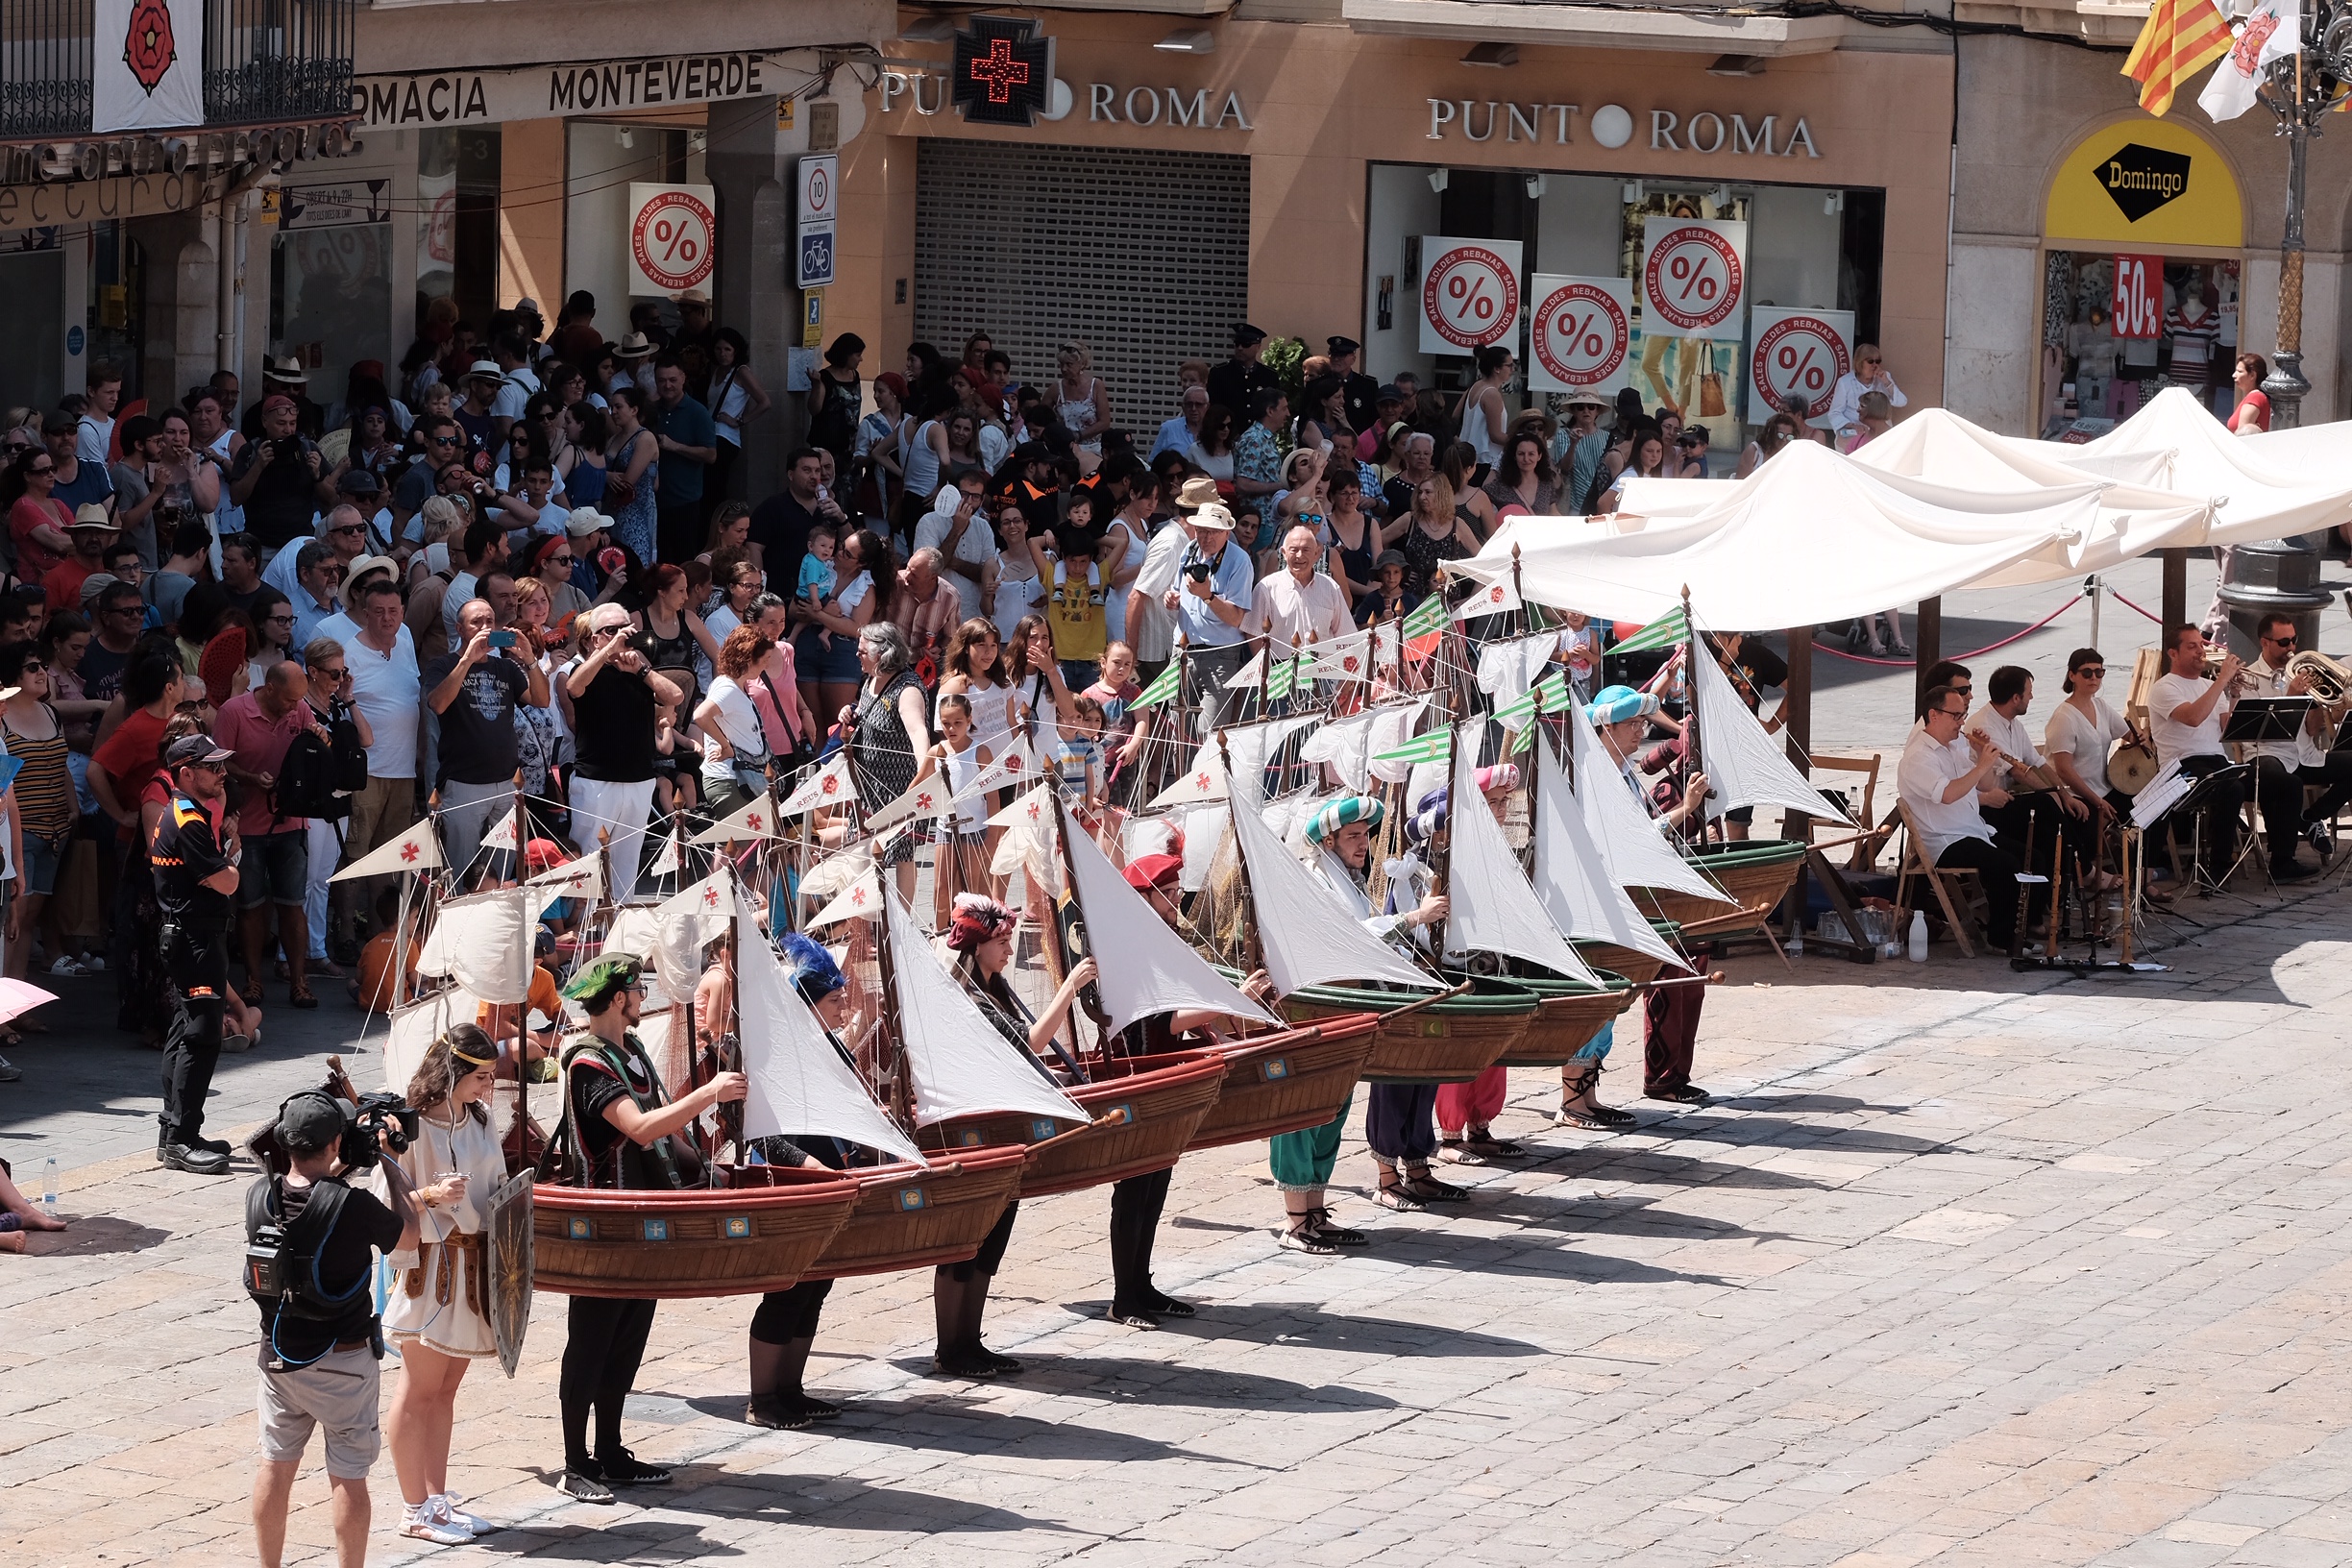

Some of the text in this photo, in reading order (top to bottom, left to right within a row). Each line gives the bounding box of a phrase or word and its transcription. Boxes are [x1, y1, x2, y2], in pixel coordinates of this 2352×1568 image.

[550, 55, 764, 111] MONTEVERDE
[1088, 83, 1255, 131] ROMA
[1425, 98, 1824, 159] PUNT ROMA
[814, 182, 823, 198] 10
[2109, 161, 2181, 198] Domingo
[306, 190, 325, 206] OBERT
[341, 189, 353, 202] 22H
[668, 195, 703, 213] REBAJAS
[638, 199, 661, 228] SOLDES
[635, 235, 647, 263] SALES
[655, 220, 697, 261] %
[1652, 234, 1678, 263] SOLDES
[1685, 231, 1726, 250] REBAJAS
[1430, 254, 1457, 282] SOLDES
[1463, 250, 1502, 270] REBAJAS
[1727, 254, 1739, 284] SALES
[648, 269, 684, 286] REBAJAS
[1504, 274, 1515, 305] SALES
[1649, 272, 1660, 303] SALES
[1671, 257, 1717, 300] %
[1427, 291, 1438, 321] SALES
[1449, 276, 1493, 319] %
[1539, 291, 1565, 320] SOLDES
[1573, 287, 1612, 307] REBAJAS
[1709, 292, 1736, 322] SOLDES
[2116, 259, 2156, 335] 50%
[1439, 325, 1479, 344] REBAJAS
[1485, 311, 1512, 341] SOLDES
[1557, 313, 1603, 356] %
[1613, 311, 1625, 342] SALES
[1759, 324, 1786, 353] SOLDES
[1793, 320, 1833, 339] REBAJAS
[1536, 328, 1547, 358] SALES
[1549, 362, 1587, 382] REBAJAS
[1595, 349, 1622, 379] SOLDES
[1778, 346, 1825, 390] %
[1835, 344, 1847, 375] SALES
[1756, 361, 1768, 392] SALES
[1467, 599, 1487, 613] REUS
[978, 771, 1003, 789] REUS
[796, 791, 819, 808] REUS
